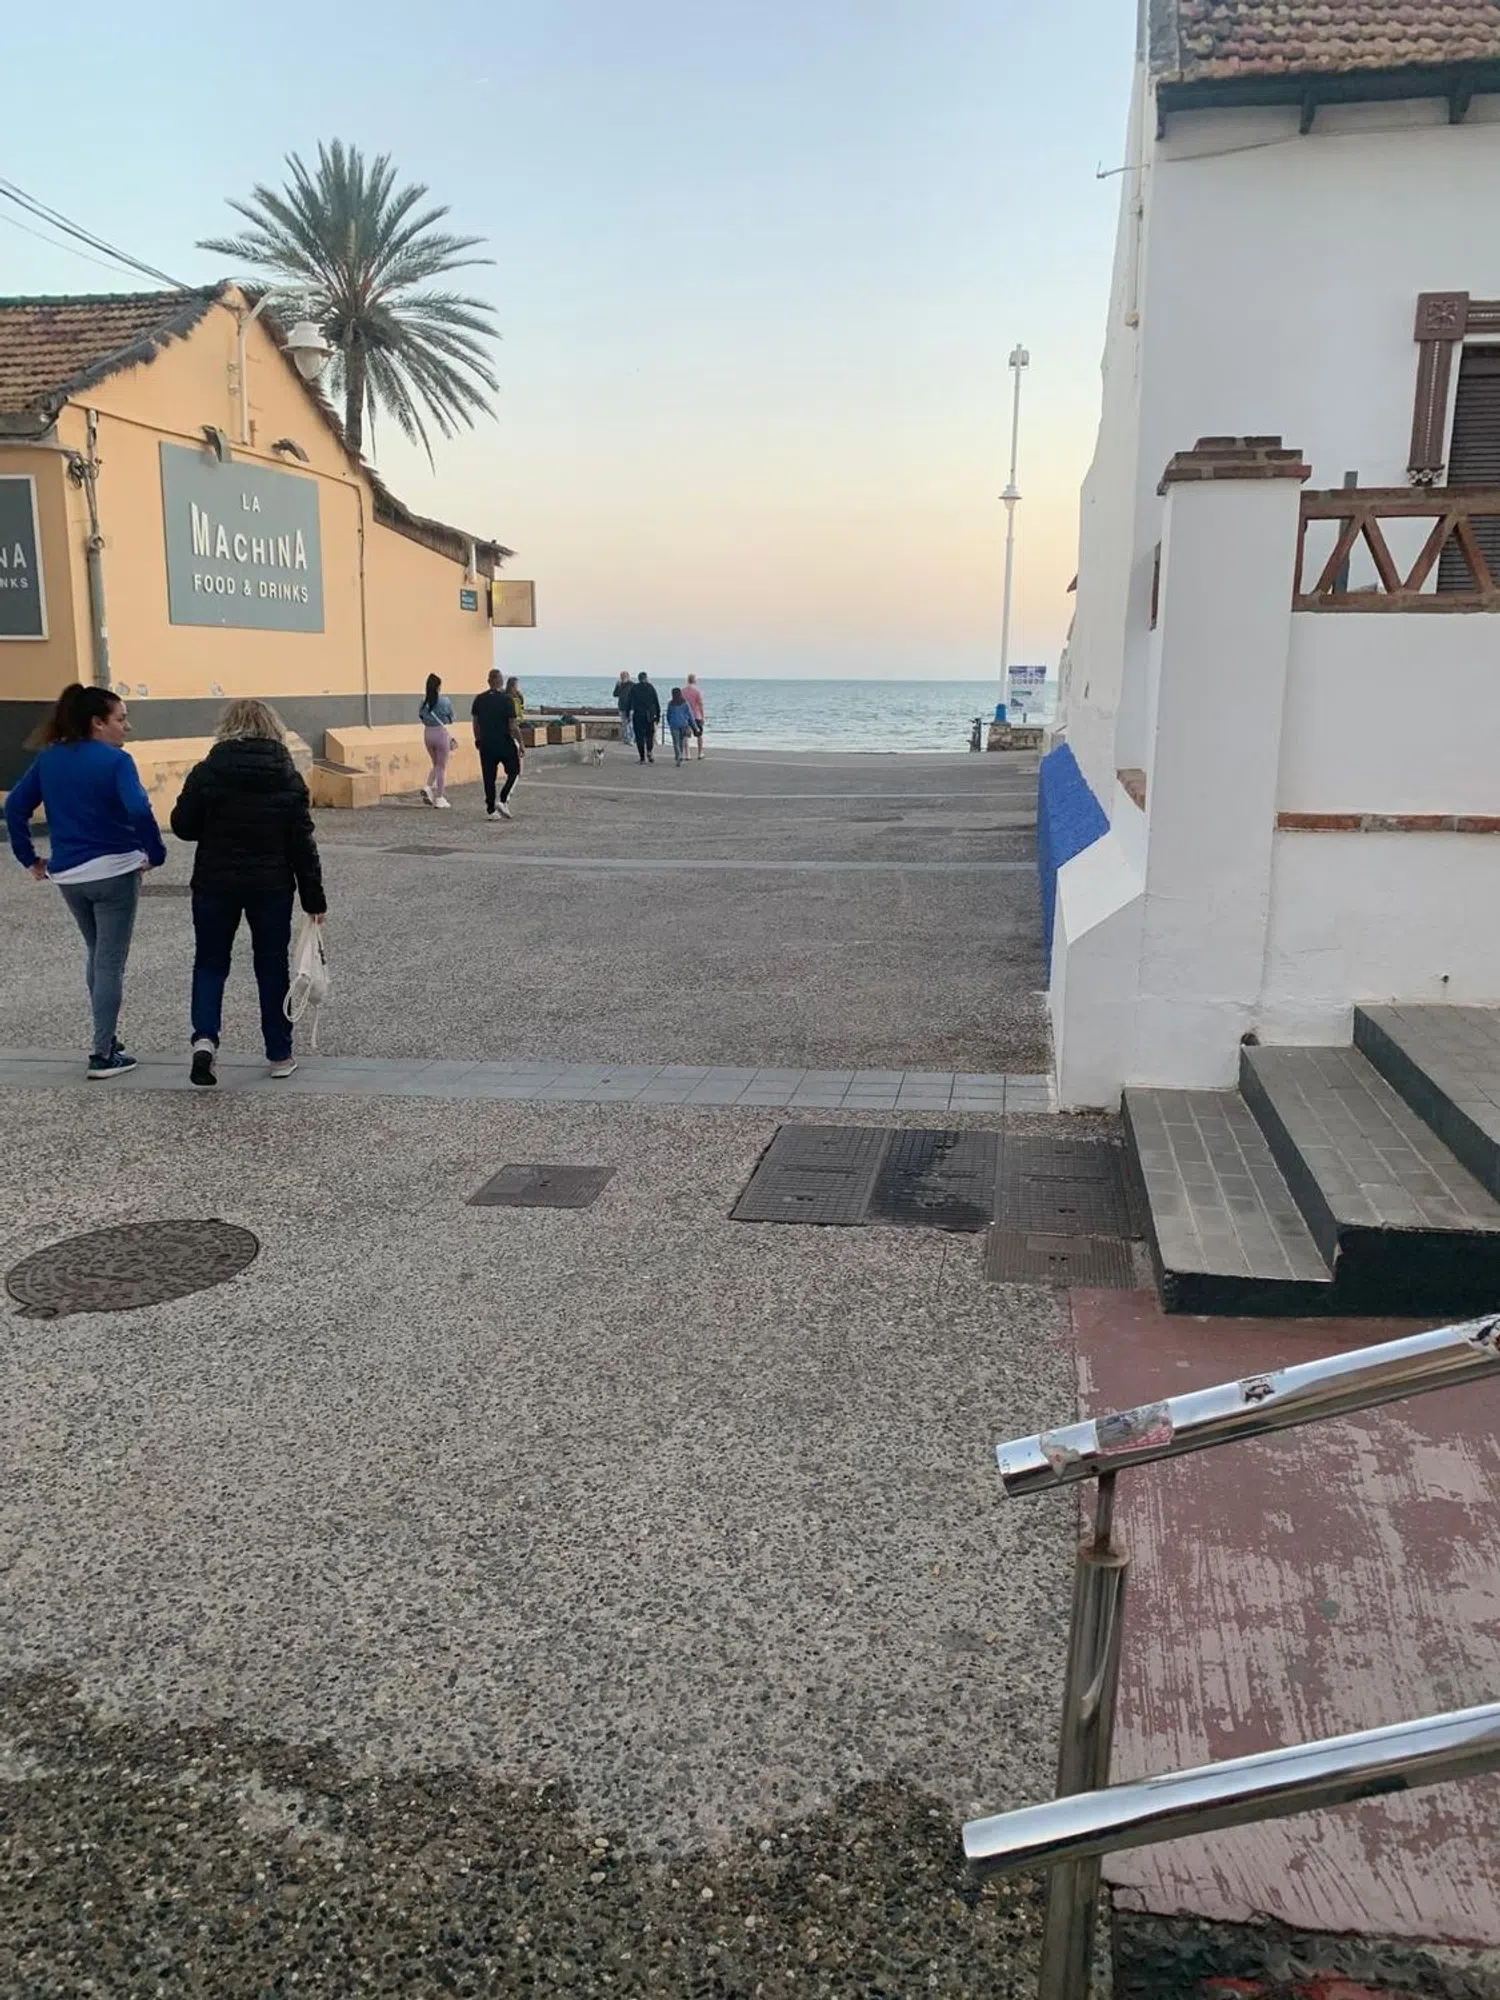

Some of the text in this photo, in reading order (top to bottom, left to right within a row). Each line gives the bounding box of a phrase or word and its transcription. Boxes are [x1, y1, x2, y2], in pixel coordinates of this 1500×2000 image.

[241, 493, 261, 513] LA
[190, 501, 308, 570] MACHINA
[194, 573, 309, 603] FOOD & DRINKS
